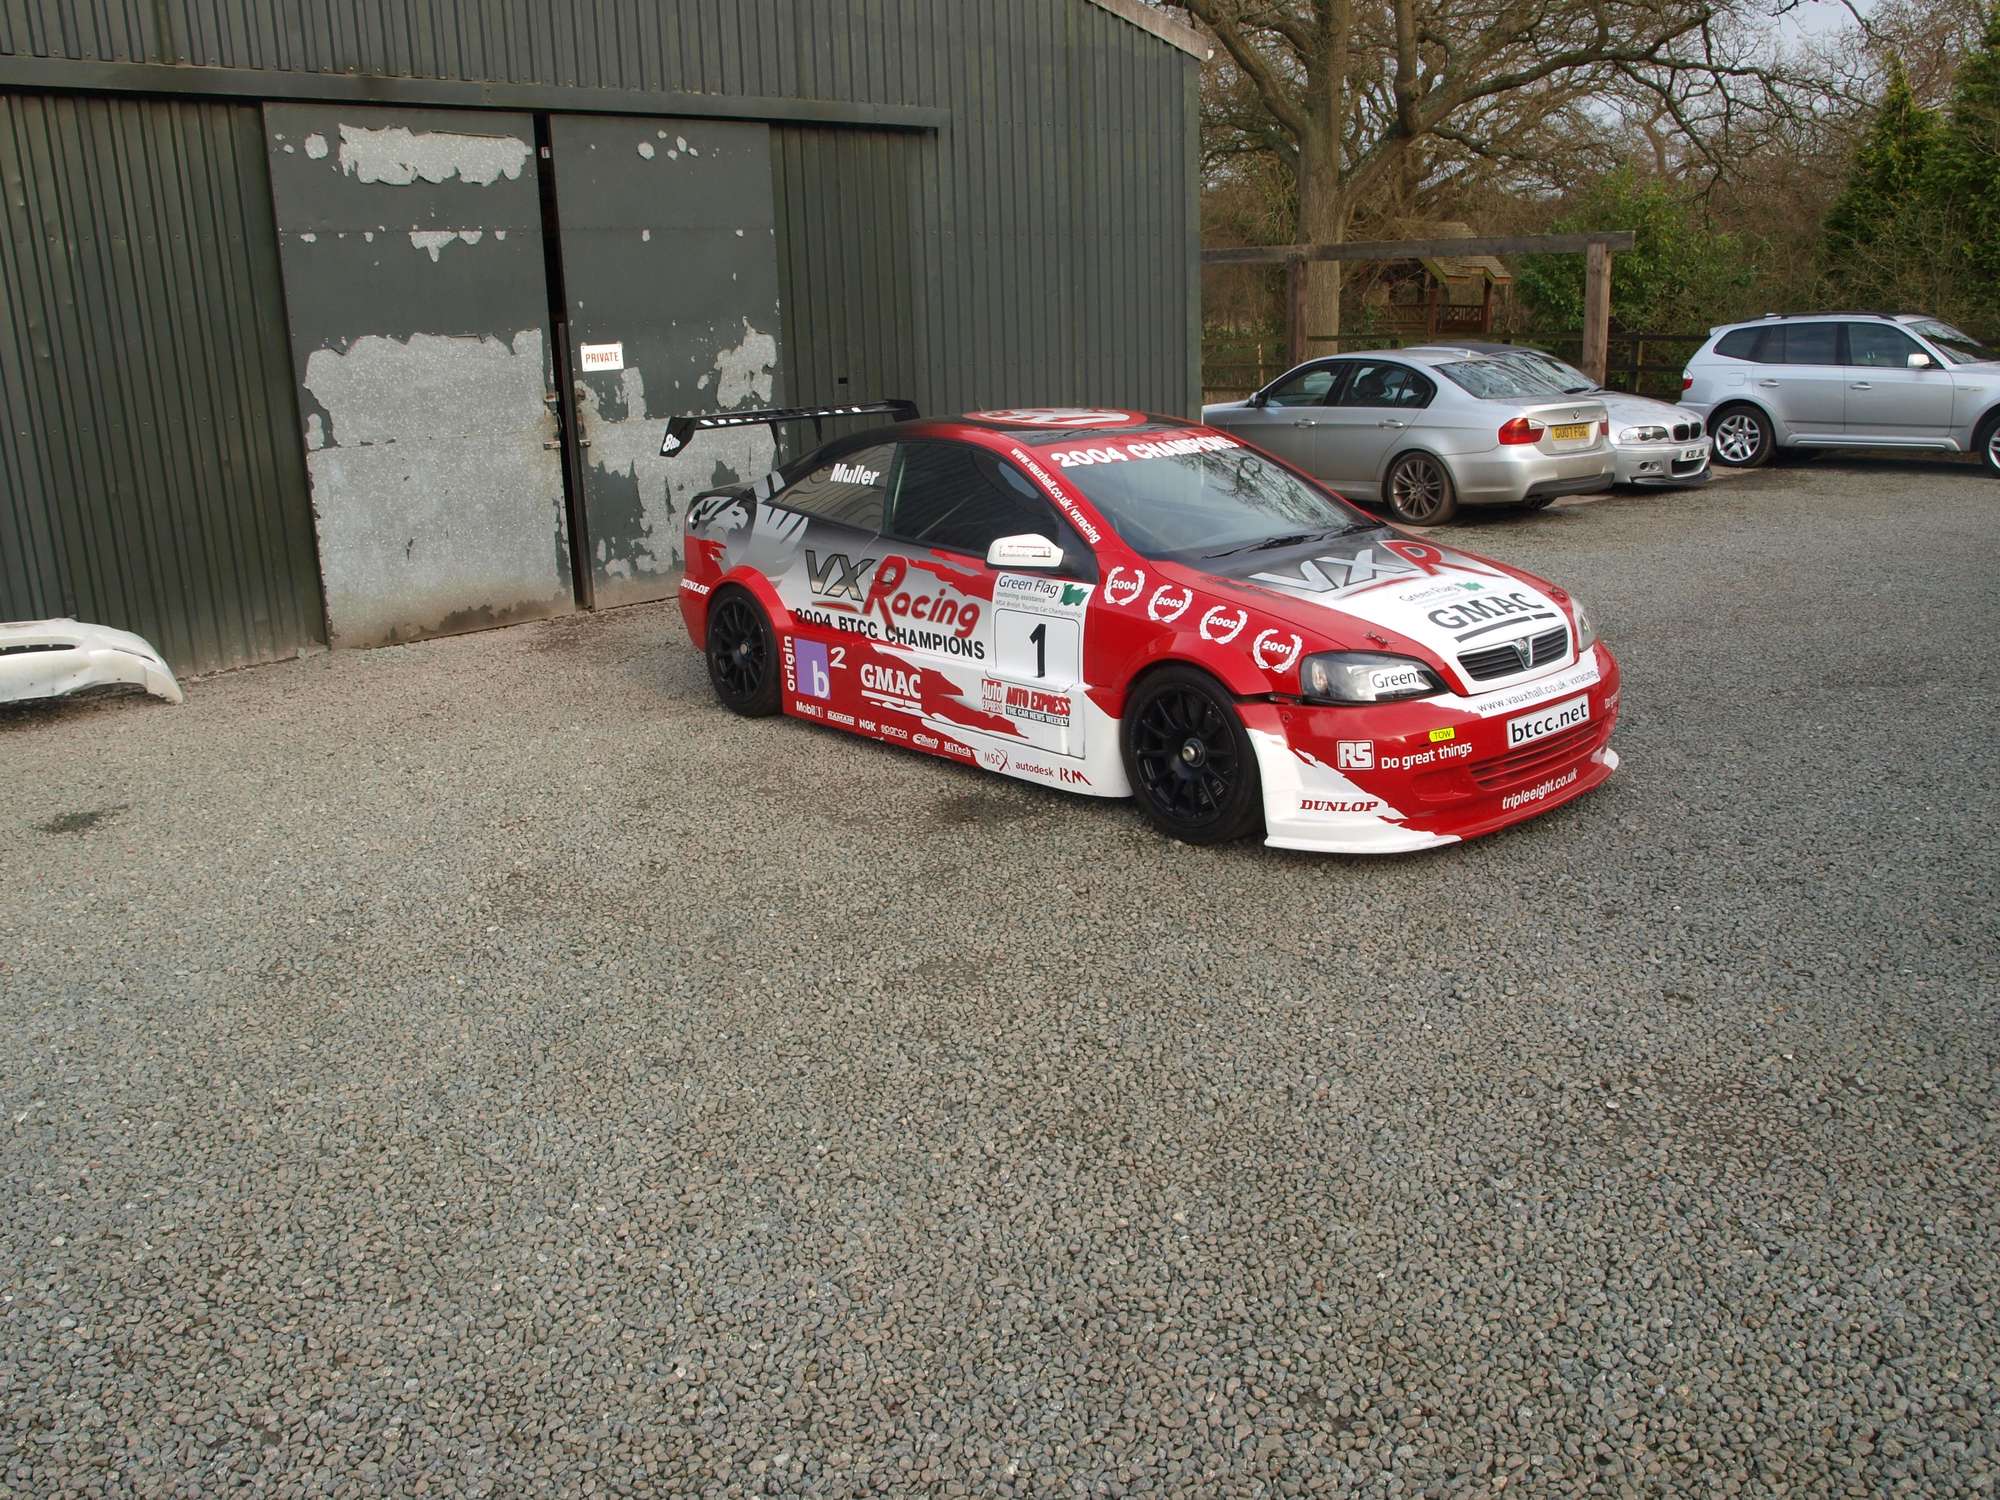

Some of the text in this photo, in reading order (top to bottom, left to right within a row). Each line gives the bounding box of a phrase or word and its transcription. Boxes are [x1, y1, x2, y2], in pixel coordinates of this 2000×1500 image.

[585, 352, 619, 363] PRIVATE
[1050, 436, 1240, 468] 2004 CHAMPIONS
[829, 463, 880, 486] Muller
[999, 575, 1059, 598] Green Flag
[1112, 579, 1137, 590] 2004
[1156, 596, 1184, 608] 2003
[1428, 592, 1544, 629] GMAC
[1209, 615, 1238, 629] 2002
[795, 608, 985, 660] 2004 BTCC CHAMPIONS
[1029, 623, 1046, 678] 1
[1262, 640, 1292, 655] 2001
[783, 636, 796, 692] origin
[860, 663, 922, 699] GMAC
[1371, 669, 1417, 689] Green
[1006, 687, 1072, 716] AUTO EXPRESS
[859, 718, 876, 732] NGK
[1007, 706, 1069, 726] THE CAR NEWS WEEKLY
[1511, 701, 1588, 743] btcc.net
[881, 724, 908, 739] sparco
[1434, 730, 1451, 740] TOW
[1339, 742, 1372, 768] RS
[1381, 742, 1472, 770] Do great things
[1015, 761, 1054, 777] autodesk
[1502, 768, 1578, 810] tripleeight.co.uk
[1300, 799, 1379, 812] DUNLOP
